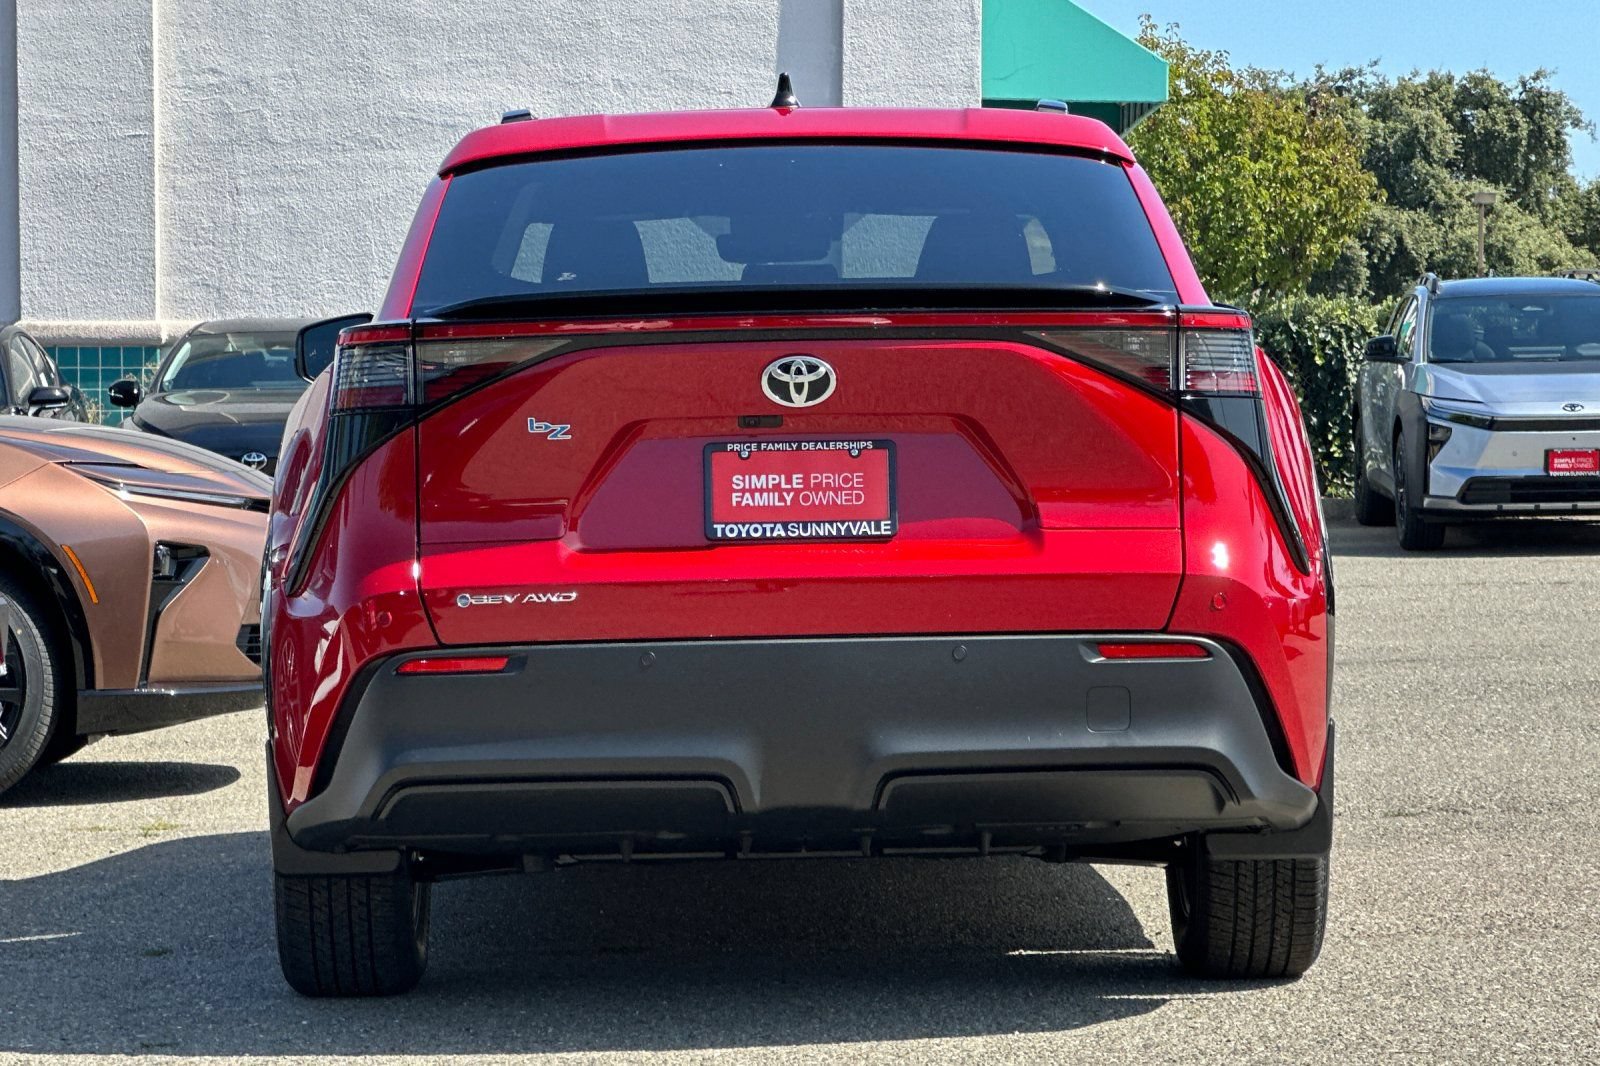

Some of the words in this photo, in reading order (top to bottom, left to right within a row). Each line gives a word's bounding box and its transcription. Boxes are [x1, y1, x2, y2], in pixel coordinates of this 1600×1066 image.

[727, 443, 758, 452] PRICE
[761, 442, 798, 451] FAMILY
[801, 441, 873, 450] DEALERSHIPS
[732, 474, 804, 489] SIMPLE
[810, 473, 864, 488] PRICE
[732, 491, 795, 507] FAMILY
[799, 491, 865, 506] OWNED
[713, 523, 786, 538] TOYOTA
[787, 521, 892, 537] SUNNYVALE
[522, 591, 577, 603] AWD
